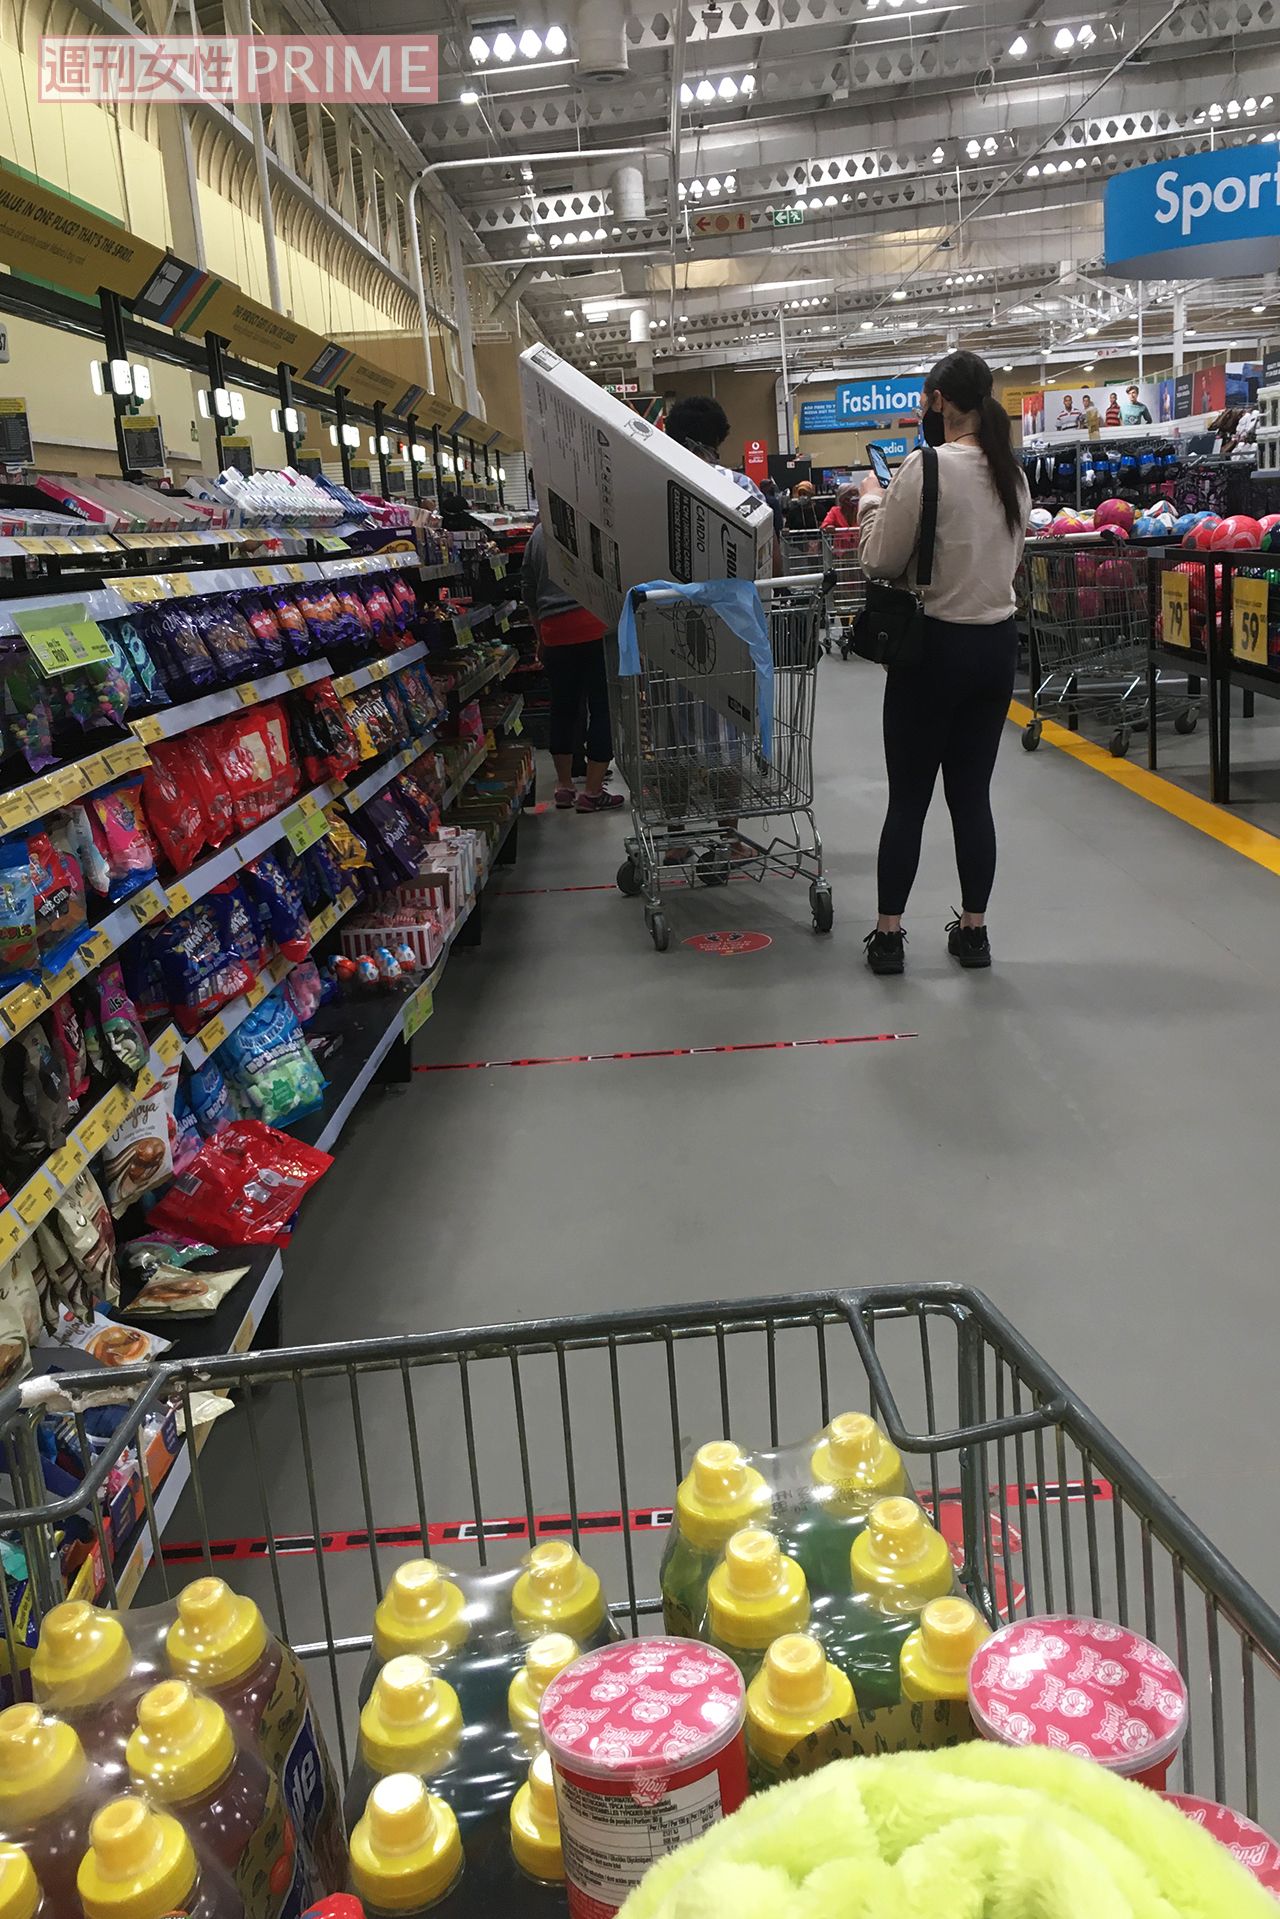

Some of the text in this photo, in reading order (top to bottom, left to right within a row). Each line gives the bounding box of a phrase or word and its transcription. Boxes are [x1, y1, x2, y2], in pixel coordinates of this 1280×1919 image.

[22, 201, 34, 218] IN
[33, 207, 54, 226] ONE
[842, 384, 921, 414] Fashion
[883, 441, 904, 454] edia
[695, 504, 706, 553] CARDIO
[1169, 601, 1183, 637] 79
[1242, 611, 1259, 652] 59
